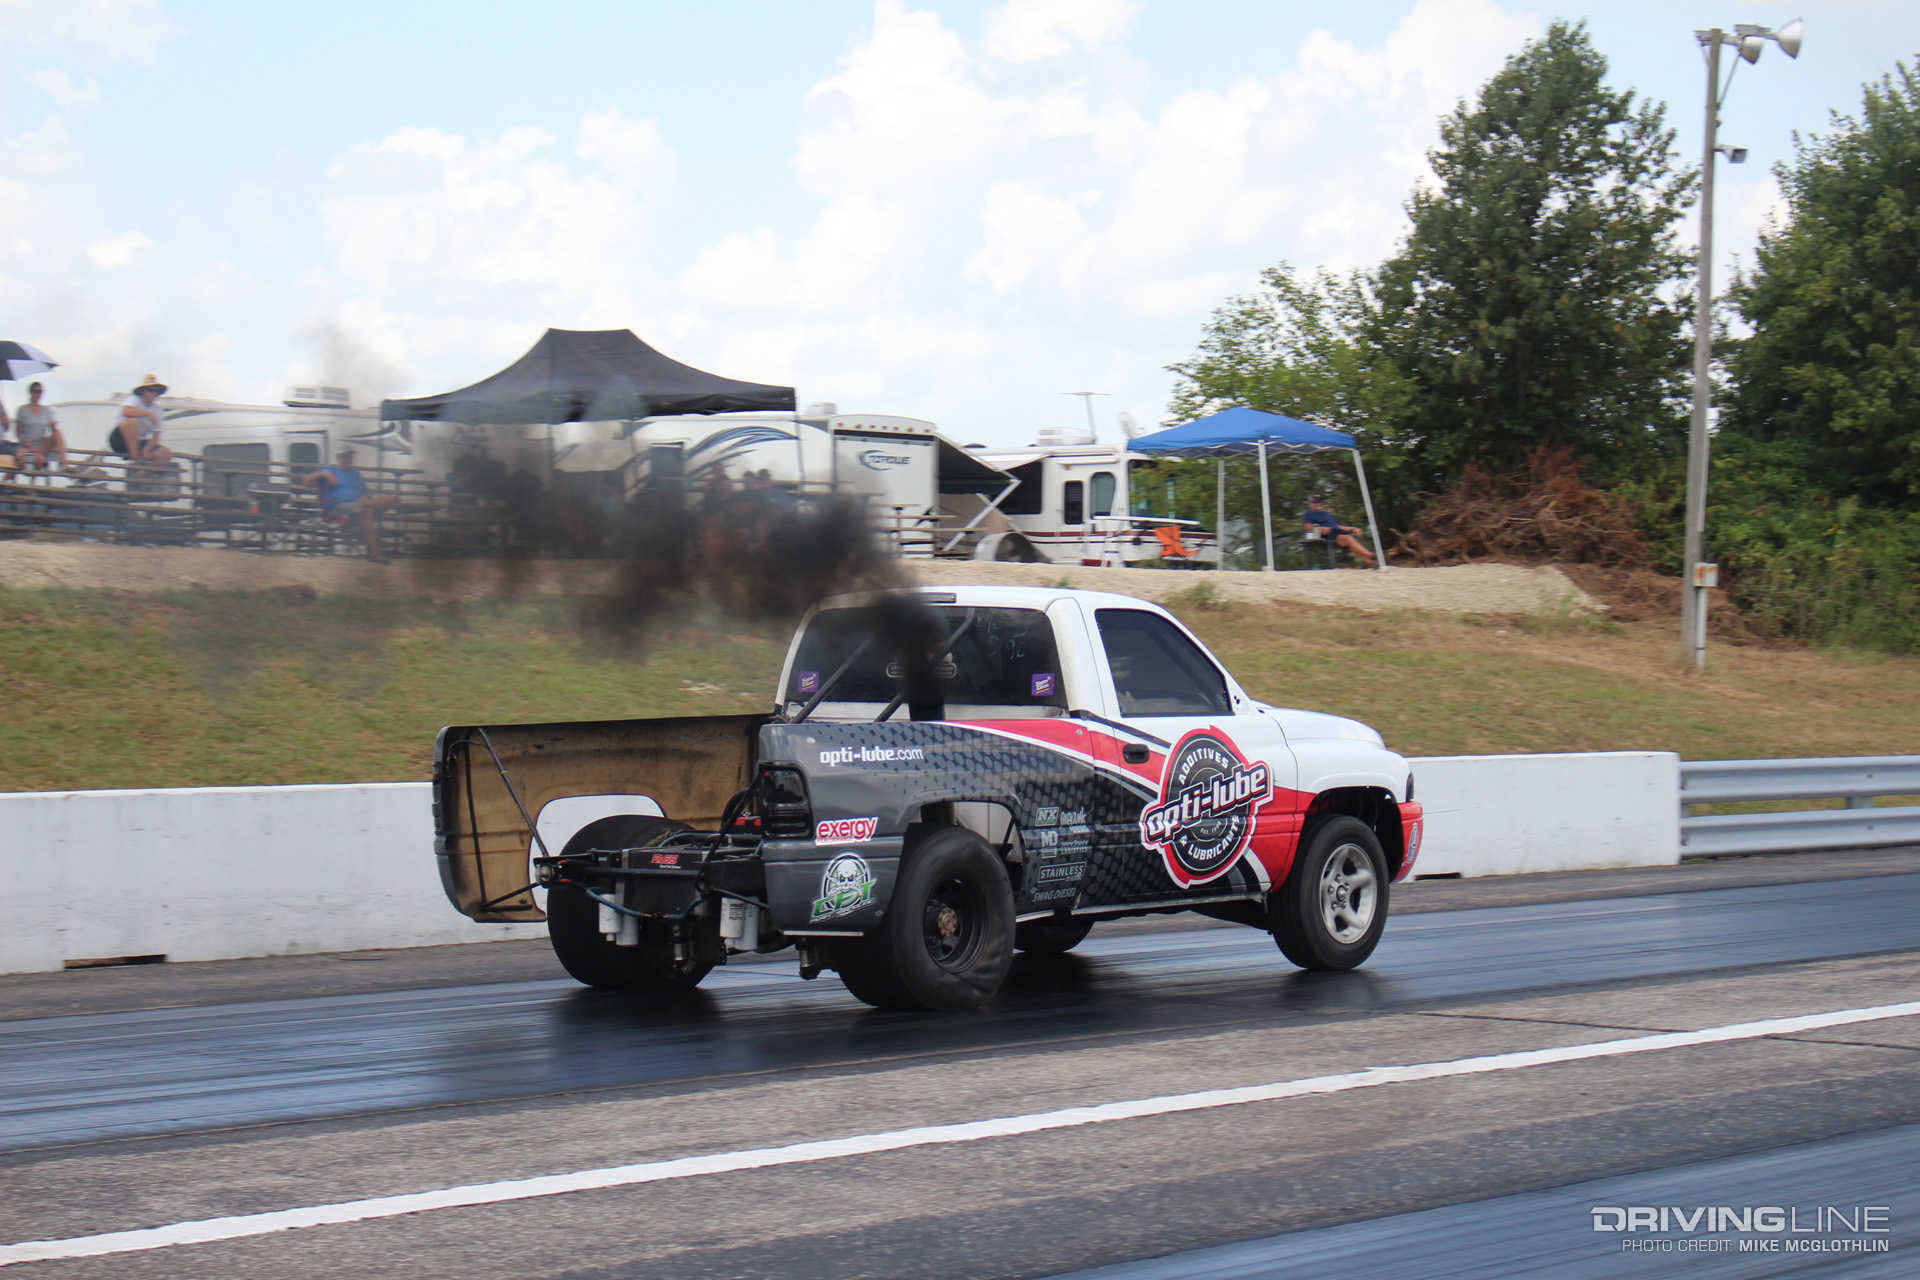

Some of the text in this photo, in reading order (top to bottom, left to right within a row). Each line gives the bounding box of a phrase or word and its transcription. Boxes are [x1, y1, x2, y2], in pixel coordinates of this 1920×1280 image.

[820, 746, 924, 767] opti-lube.com
[1179, 747, 1229, 785] ADDITIVES
[1147, 768, 1266, 838] opti-lube
[1038, 809, 1057, 821] NX
[818, 819, 877, 839] exergy
[1041, 830, 1059, 847] MD
[1187, 814, 1240, 860] LUBRICANTS
[1040, 865, 1084, 879] STAINLESS
